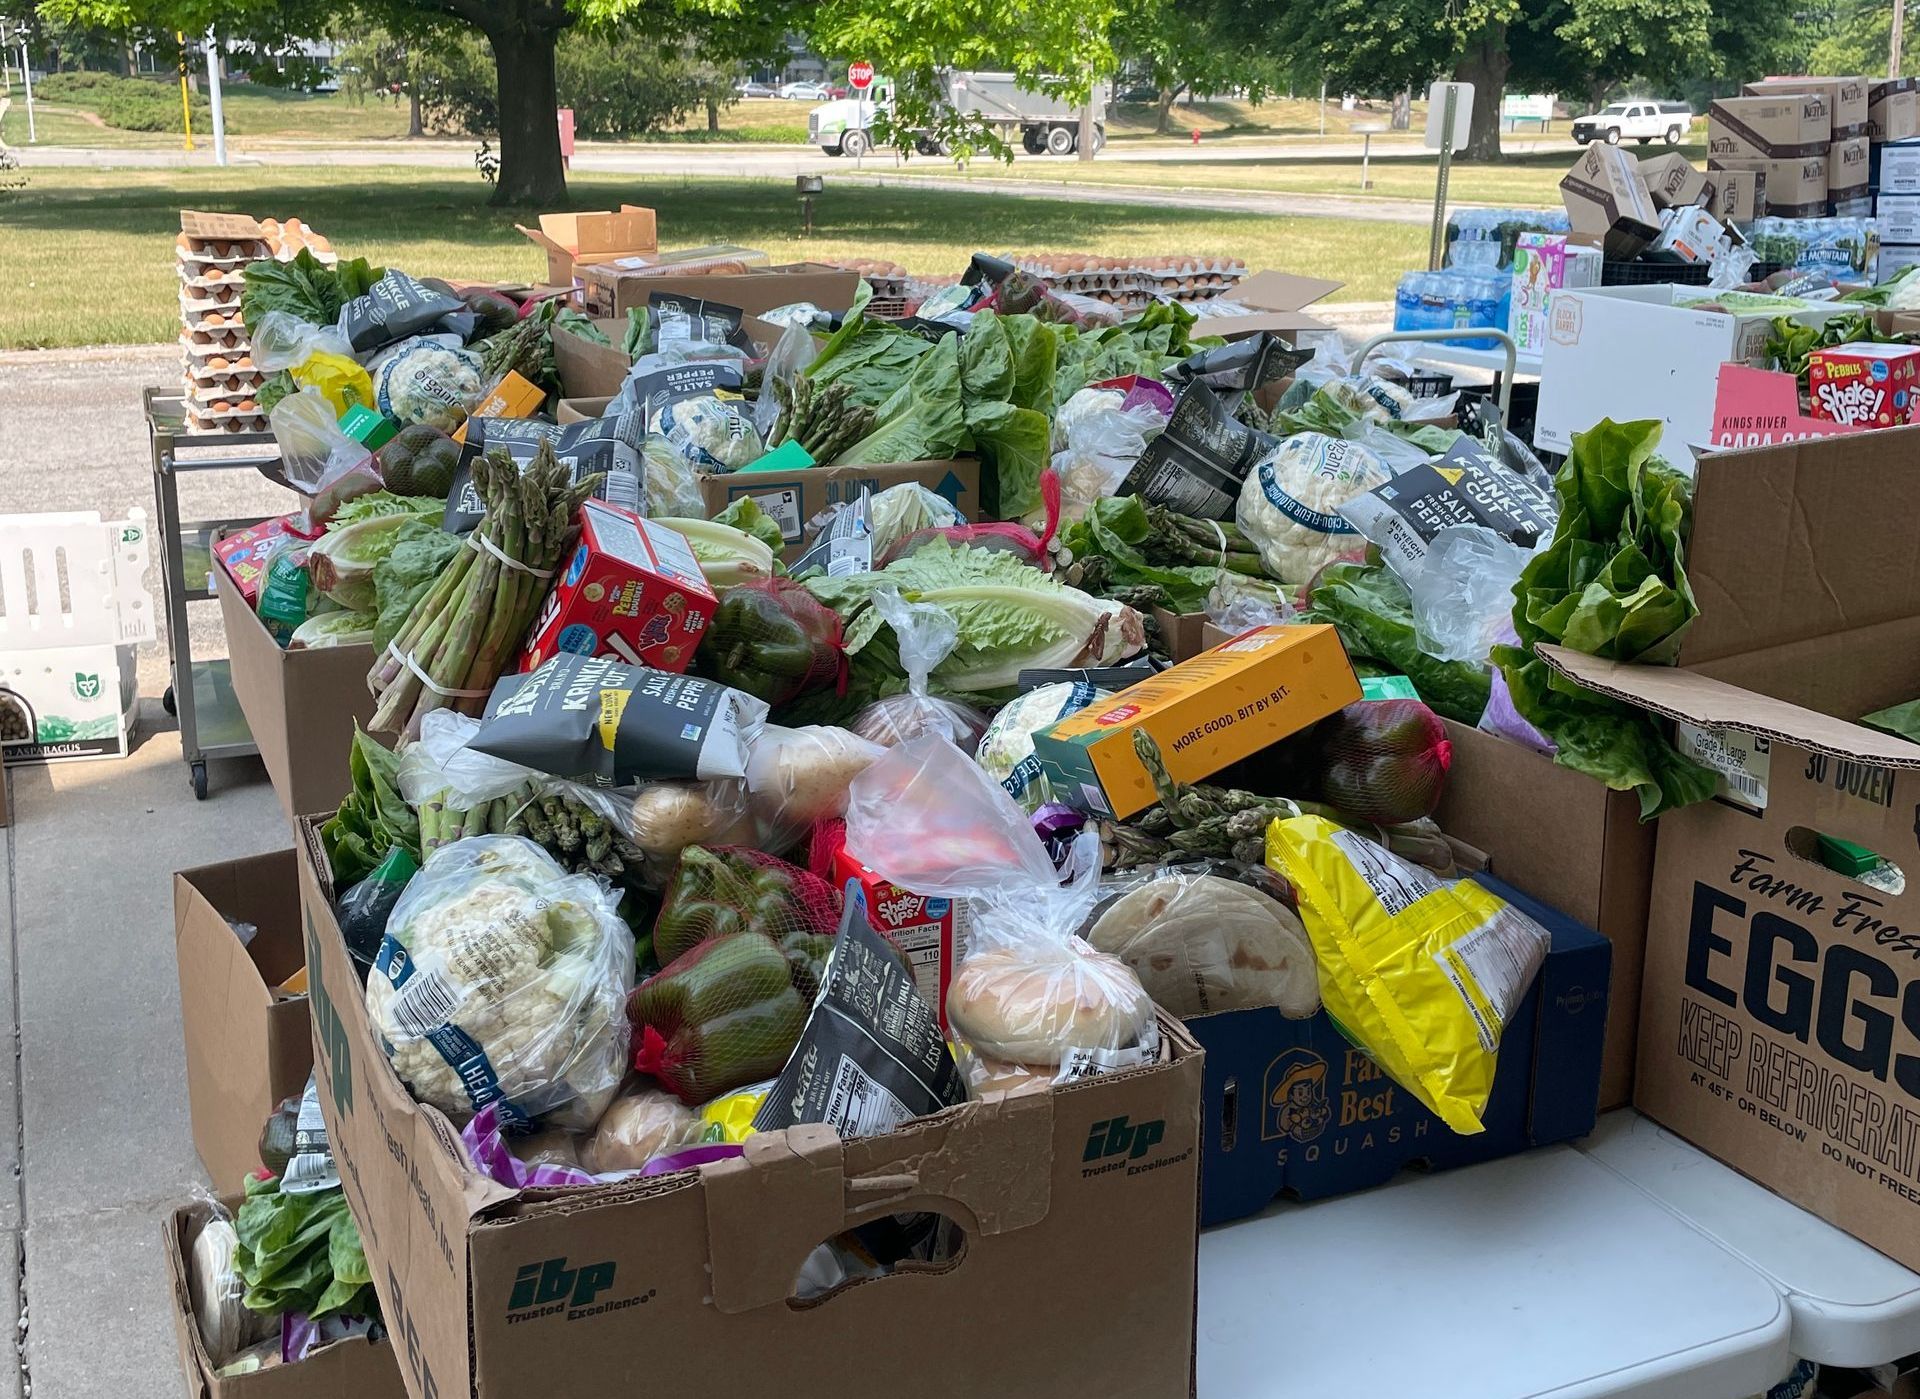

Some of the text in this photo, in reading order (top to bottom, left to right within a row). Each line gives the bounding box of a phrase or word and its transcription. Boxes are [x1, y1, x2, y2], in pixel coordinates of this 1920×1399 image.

[851, 68, 872, 80] STOP
[1808, 250, 1851, 262] MOUNTAIN
[1555, 320, 1575, 334] BARREL
[1557, 309, 1571, 321] BLOCK
[414, 369, 465, 411] organic
[665, 368, 713, 380] PEPPER
[682, 379, 712, 391] SALT
[1722, 416, 1788, 430] KINGS RIVER
[1320, 439, 1348, 480] organic
[1437, 489, 1476, 523] SALT
[1452, 456, 1539, 535] KRINKLE
[1465, 481, 1504, 515] CUT
[1410, 499, 1448, 533] PEPP
[1400, 528, 1426, 559] WEIGHT
[612, 580, 638, 618] PEBBLES
[682, 609, 695, 631] Salted
[561, 656, 613, 711] KRINKLE
[599, 668, 626, 688] CUT
[642, 677, 661, 698] SALT
[1173, 684, 1292, 753] MORE GOOD. BIT BY BIT.
[16, 742, 81, 757] ASPARAGUS
[1696, 734, 1718, 752] Grade
[1725, 742, 1747, 761] Large
[1804, 751, 1828, 784] 30
[1834, 760, 1897, 809] DOZEN
[1729, 848, 1920, 962] Farm Fres
[917, 924, 940, 934] Facts
[923, 949, 940, 961] 110
[1449, 973, 1476, 1011] NUTRIMENTAL
[921, 1045, 942, 1073] LESS
[809, 1073, 822, 1103] BRAND
[826, 1062, 851, 1126] trition Facts
[853, 1074, 866, 1100] 290
[1677, 996, 1920, 1185] KEEP REFRIGERAT
[1338, 1088, 1394, 1127] Best
[1081, 1114, 1166, 1163] ibp
[1276, 1118, 1429, 1166] SQUASH
[1690, 1071, 1706, 1088] AT
[1737, 1097, 1757, 1116] OR
[1759, 1108, 1808, 1143] BELOW
[1821, 1141, 1843, 1162] DO
[1846, 1154, 1876, 1180] NOT
[1879, 1172, 1920, 1206] FREE
[1081, 1160, 1126, 1179] Trusted
[380, 1107, 409, 1175] Fresh
[440, 1225, 457, 1280] Inc.
[507, 1255, 618, 1310] ibp
[505, 1300, 565, 1325] Trusted
